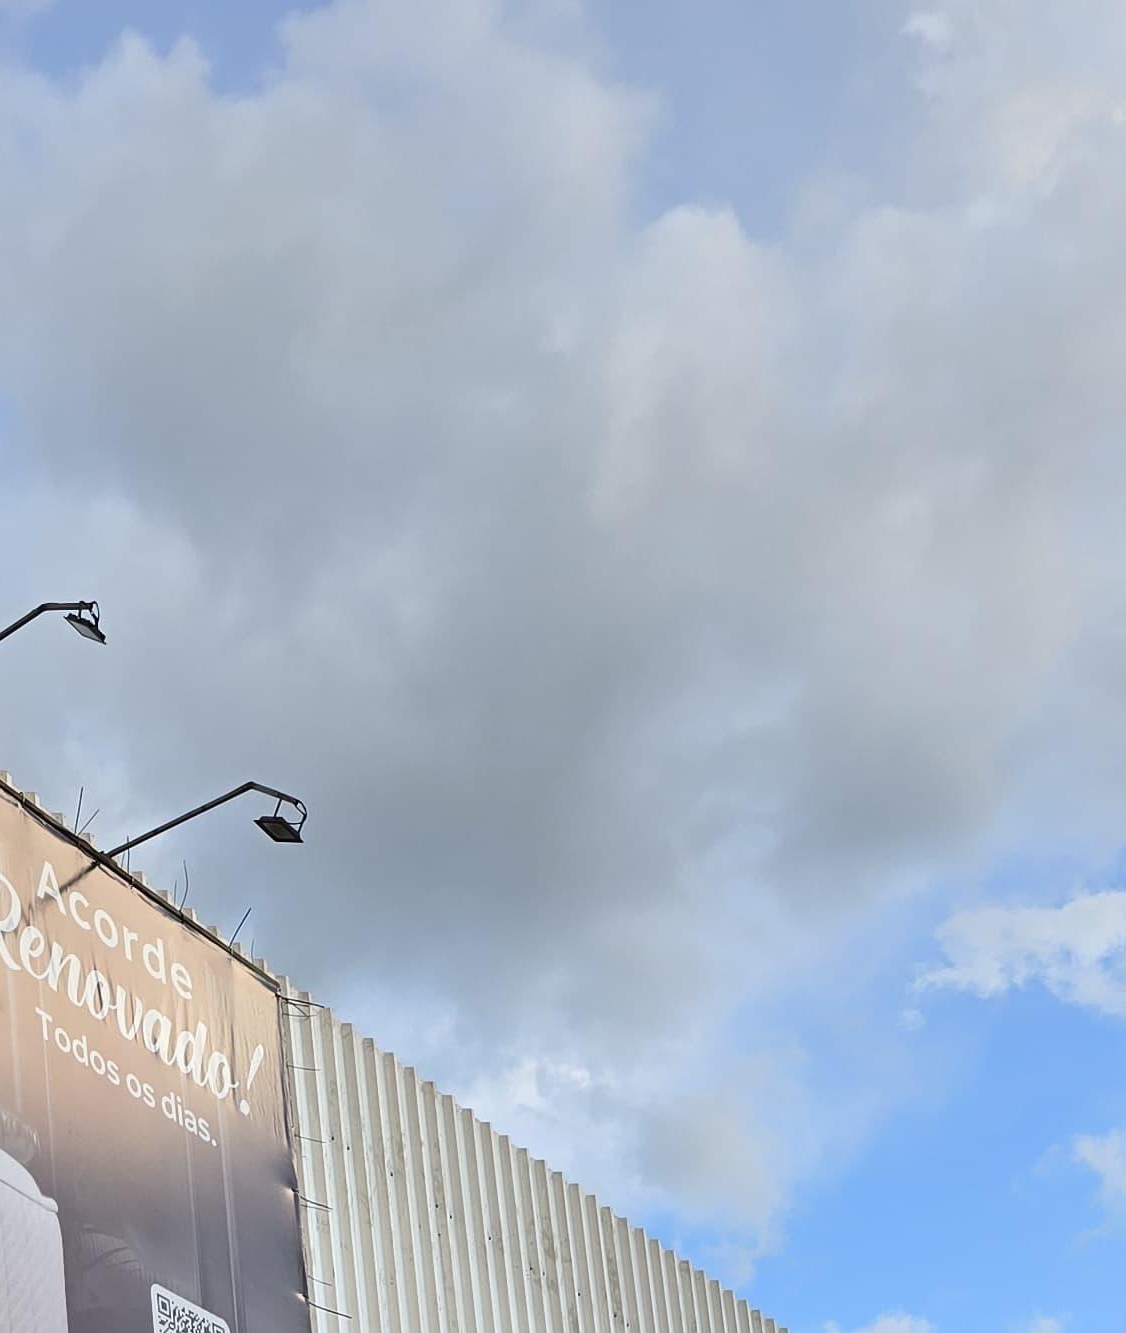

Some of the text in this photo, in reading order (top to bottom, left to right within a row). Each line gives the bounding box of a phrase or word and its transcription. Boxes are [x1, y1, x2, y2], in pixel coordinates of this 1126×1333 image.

[37, 860, 193, 1000] Acorde
[35, 1006, 217, 1147] Todos os dias.
